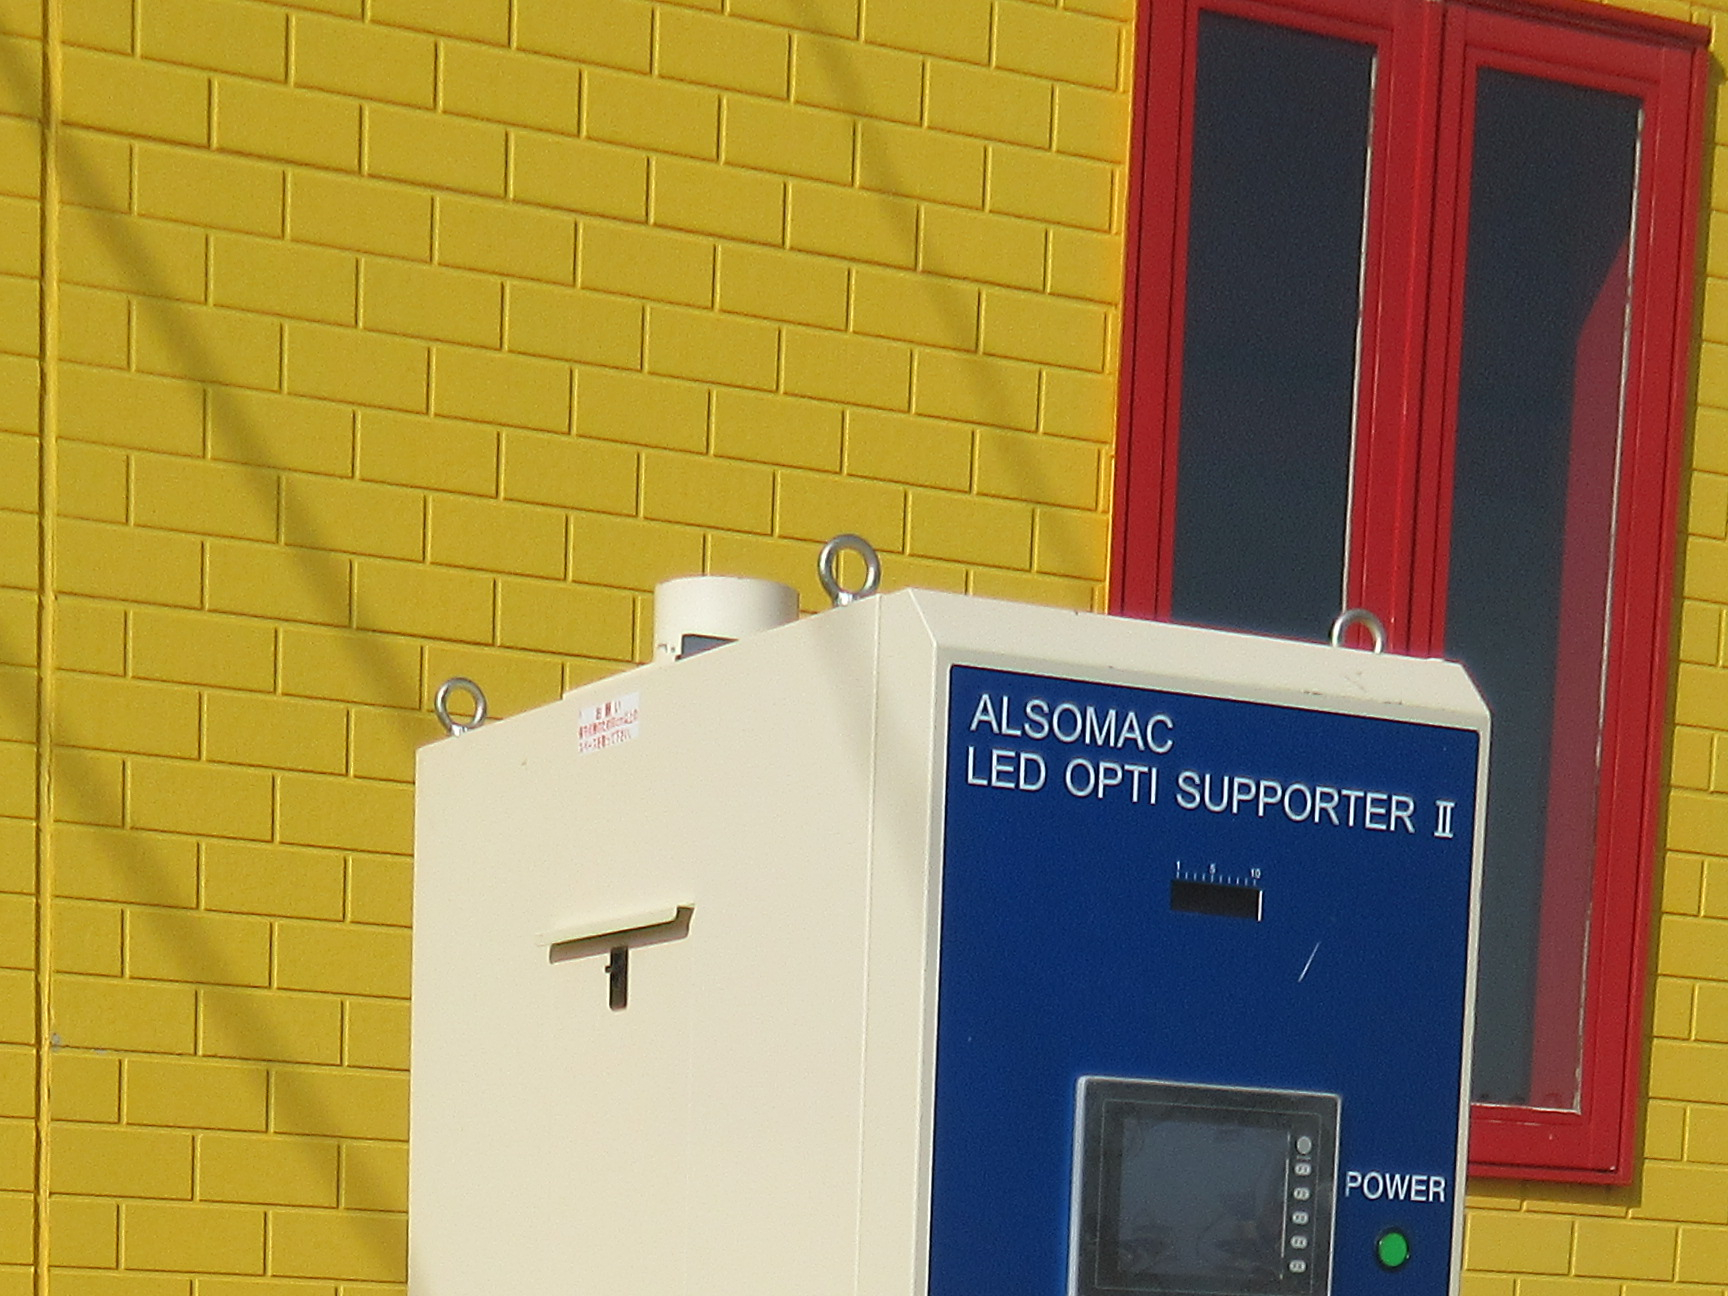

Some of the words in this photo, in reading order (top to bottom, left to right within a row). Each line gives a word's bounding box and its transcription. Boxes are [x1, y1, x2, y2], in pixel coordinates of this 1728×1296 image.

[970, 693, 1174, 754] ALSOMAC
[967, 745, 1046, 791] LED
[1065, 758, 1157, 804] OPTI
[1176, 770, 1415, 833] SUPPORTER
[1251, 868, 1261, 879] 10
[1345, 1171, 1445, 1202] POWER
